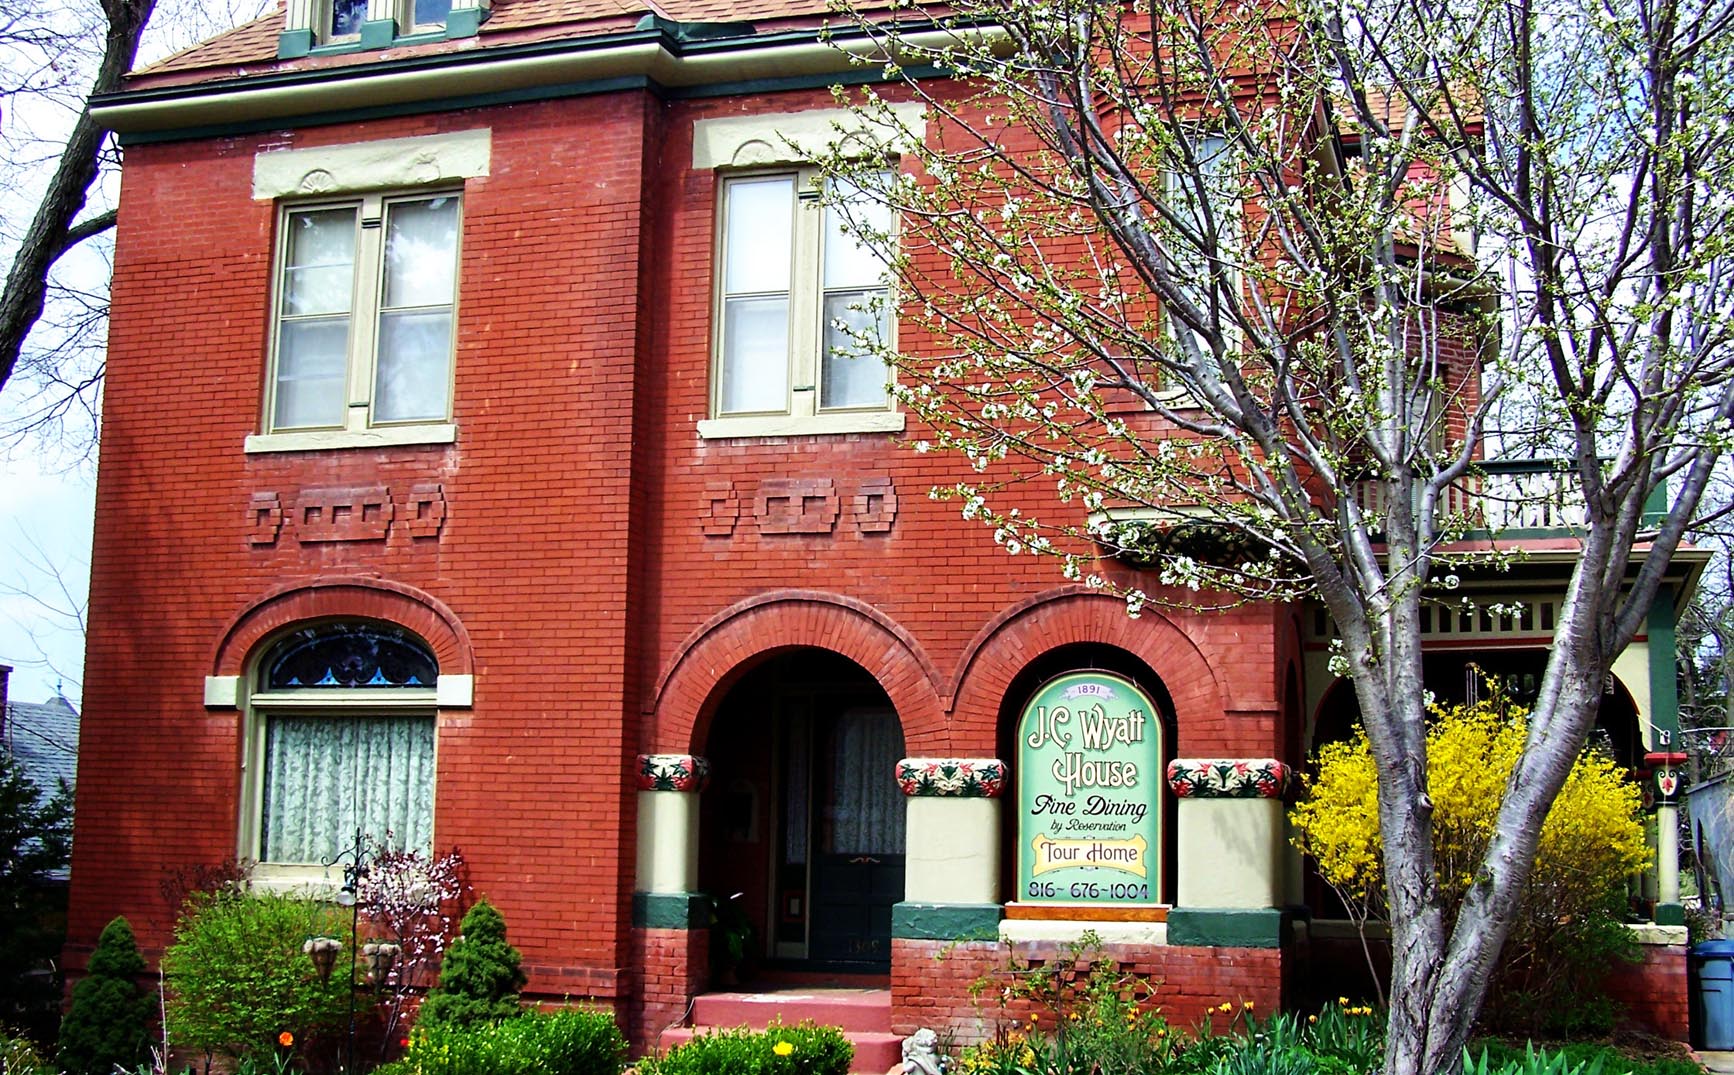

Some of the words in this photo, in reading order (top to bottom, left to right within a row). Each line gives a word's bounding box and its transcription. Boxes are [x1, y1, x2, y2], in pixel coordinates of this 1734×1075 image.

[1078, 685, 1100, 694] 1891
[1027, 706, 1072, 749] J.C.
[1078, 703, 1145, 751] Wyatt
[1052, 752, 1137, 796] House
[1031, 795, 1076, 815] Fine
[1082, 796, 1148, 824] Dining
[1050, 820, 1063, 834] by
[1065, 819, 1126, 831] Reservation
[1040, 842, 1080, 862] Tour
[1086, 843, 1137, 862] Home
